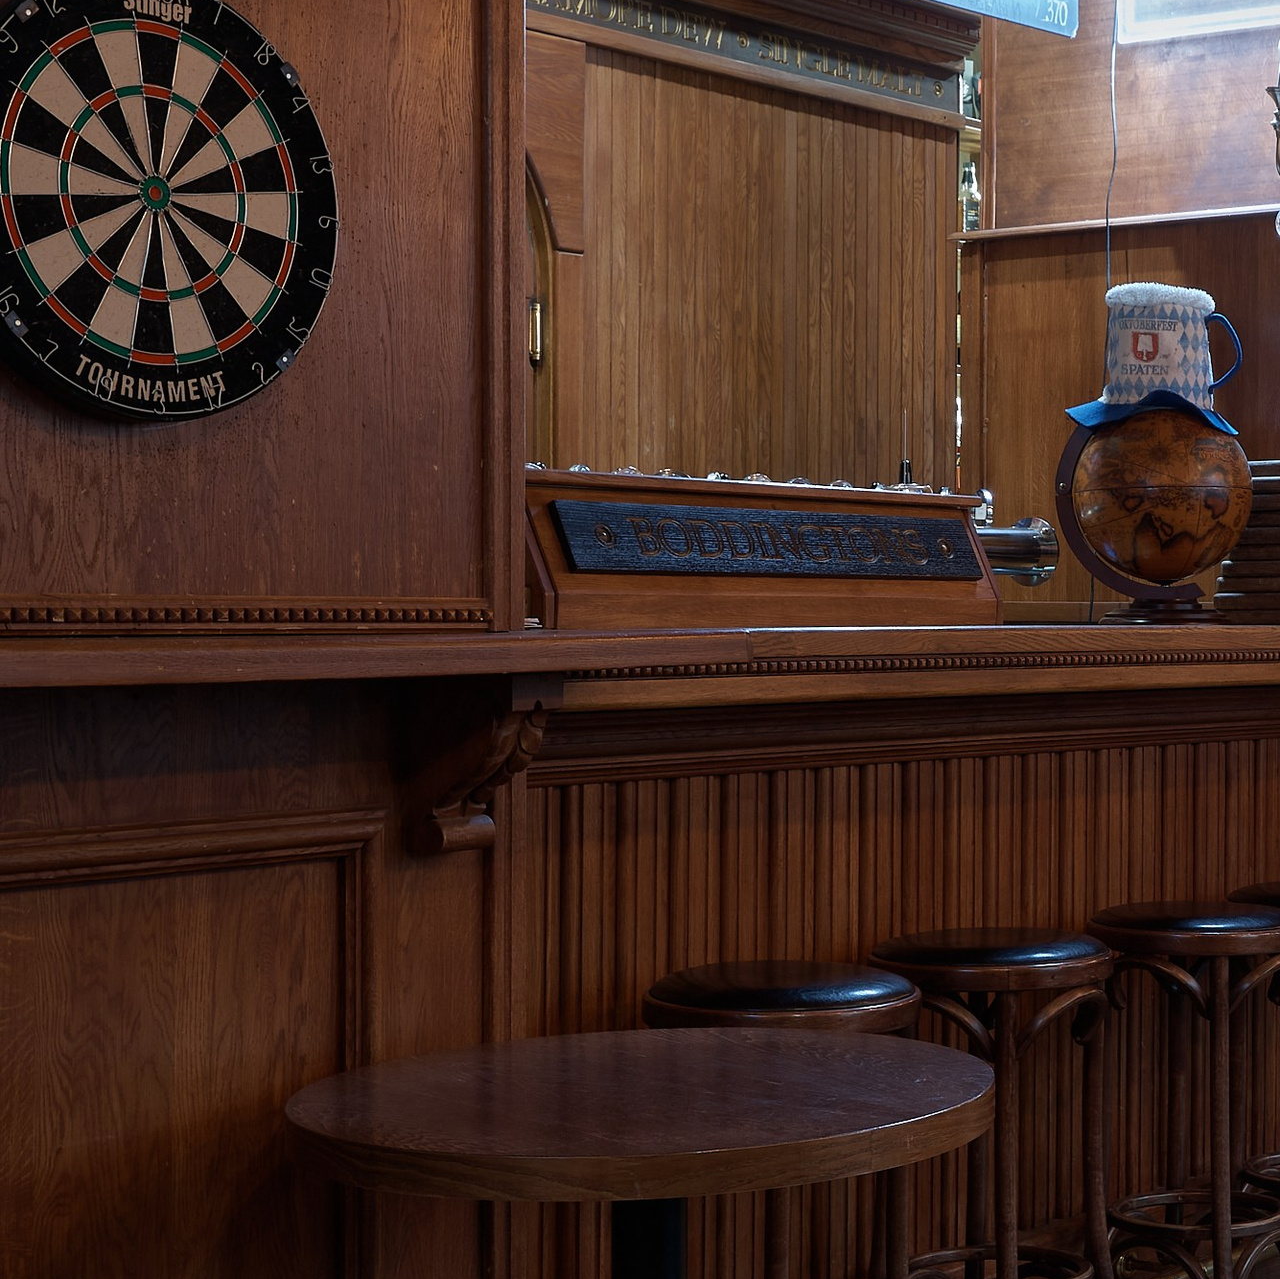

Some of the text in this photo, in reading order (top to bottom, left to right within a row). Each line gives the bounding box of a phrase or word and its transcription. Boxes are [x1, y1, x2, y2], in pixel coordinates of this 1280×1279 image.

[660, 5, 728, 50] DEW
[756, 30, 853, 82] SINGLE
[856, 55, 927, 98] MALT
[1119, 319, 1179, 333] OKTOBERFEST
[75, 353, 227, 403] TOURNAMENT
[1120, 363, 1170, 376] SPATEN
[625, 516, 931, 567] BODDINGTONS
